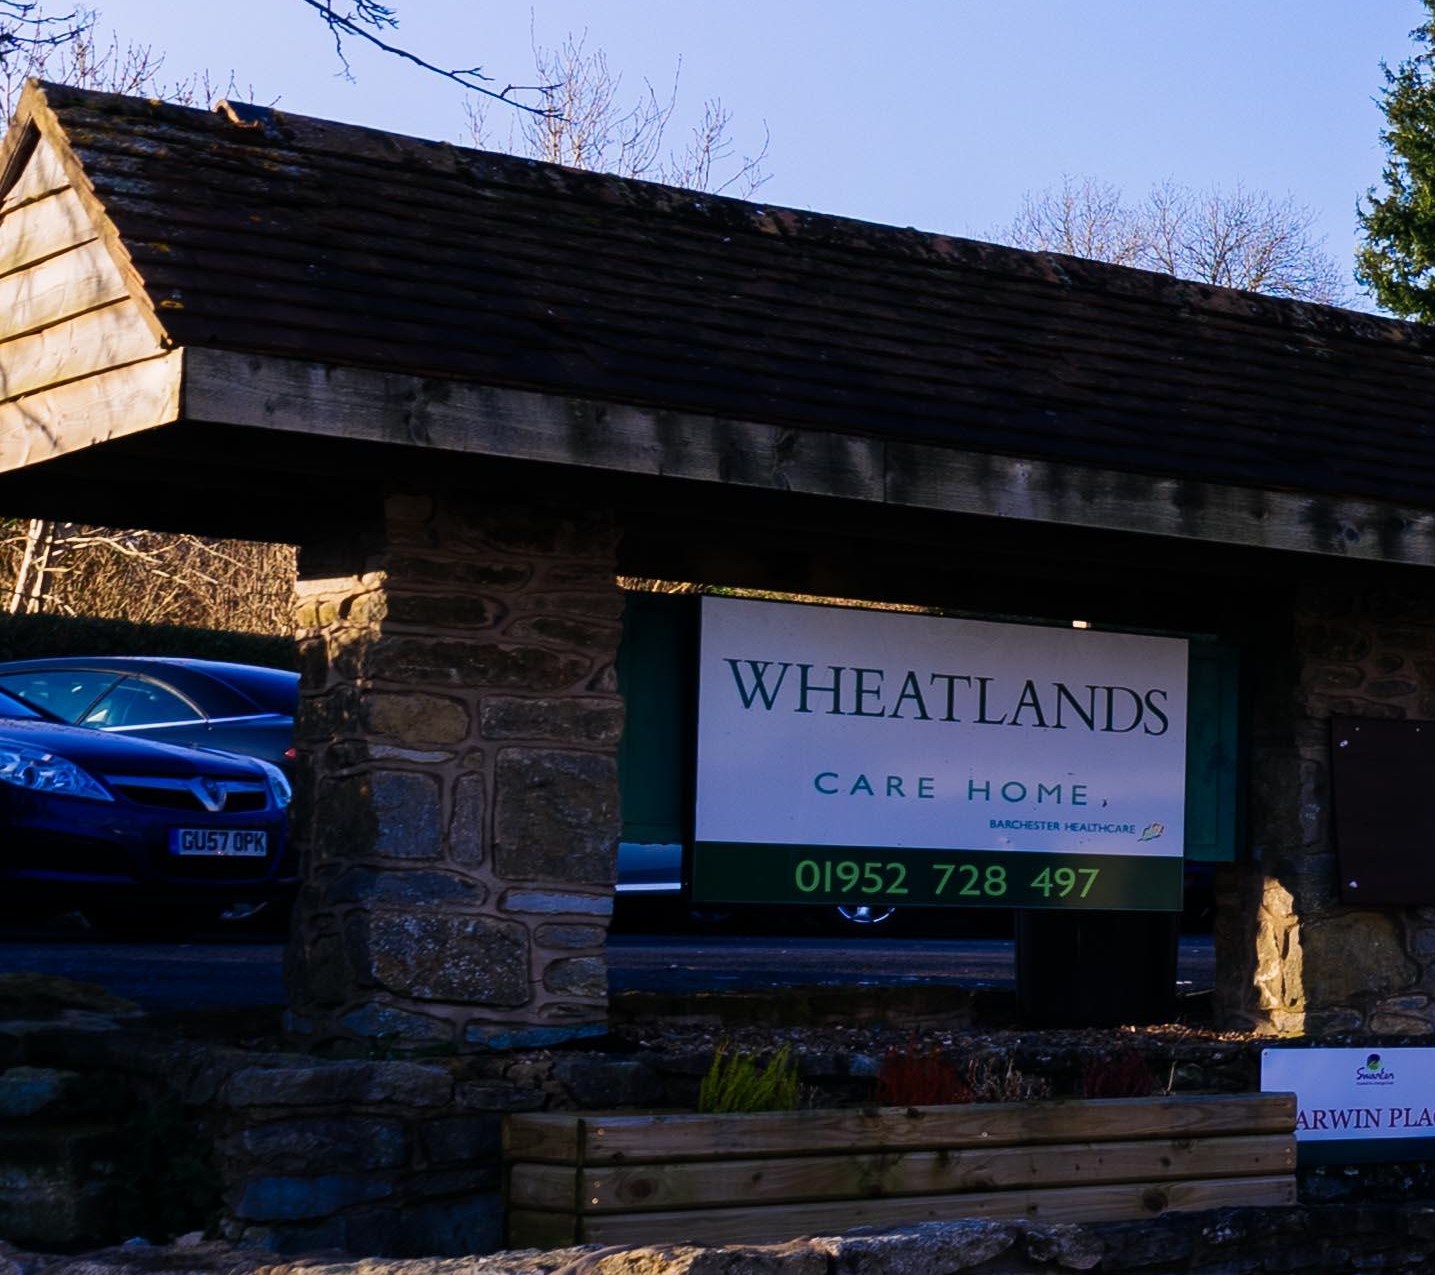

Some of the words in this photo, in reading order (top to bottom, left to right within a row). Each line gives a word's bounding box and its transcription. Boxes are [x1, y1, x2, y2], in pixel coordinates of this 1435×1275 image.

[722, 657, 1169, 736] WHEATLANDS
[813, 771, 935, 799] CARE
[967, 778, 1089, 806] HOME
[182, 830, 229, 851] GU57
[989, 819, 1060, 832] BARCHESTER
[1064, 822, 1136, 834] HEALTHCARE
[795, 859, 909, 896] 01952
[931, 863, 1008, 897] 728
[1030, 866, 1100, 899] 497
[1296, 1107, 1383, 1131] ARWIN
